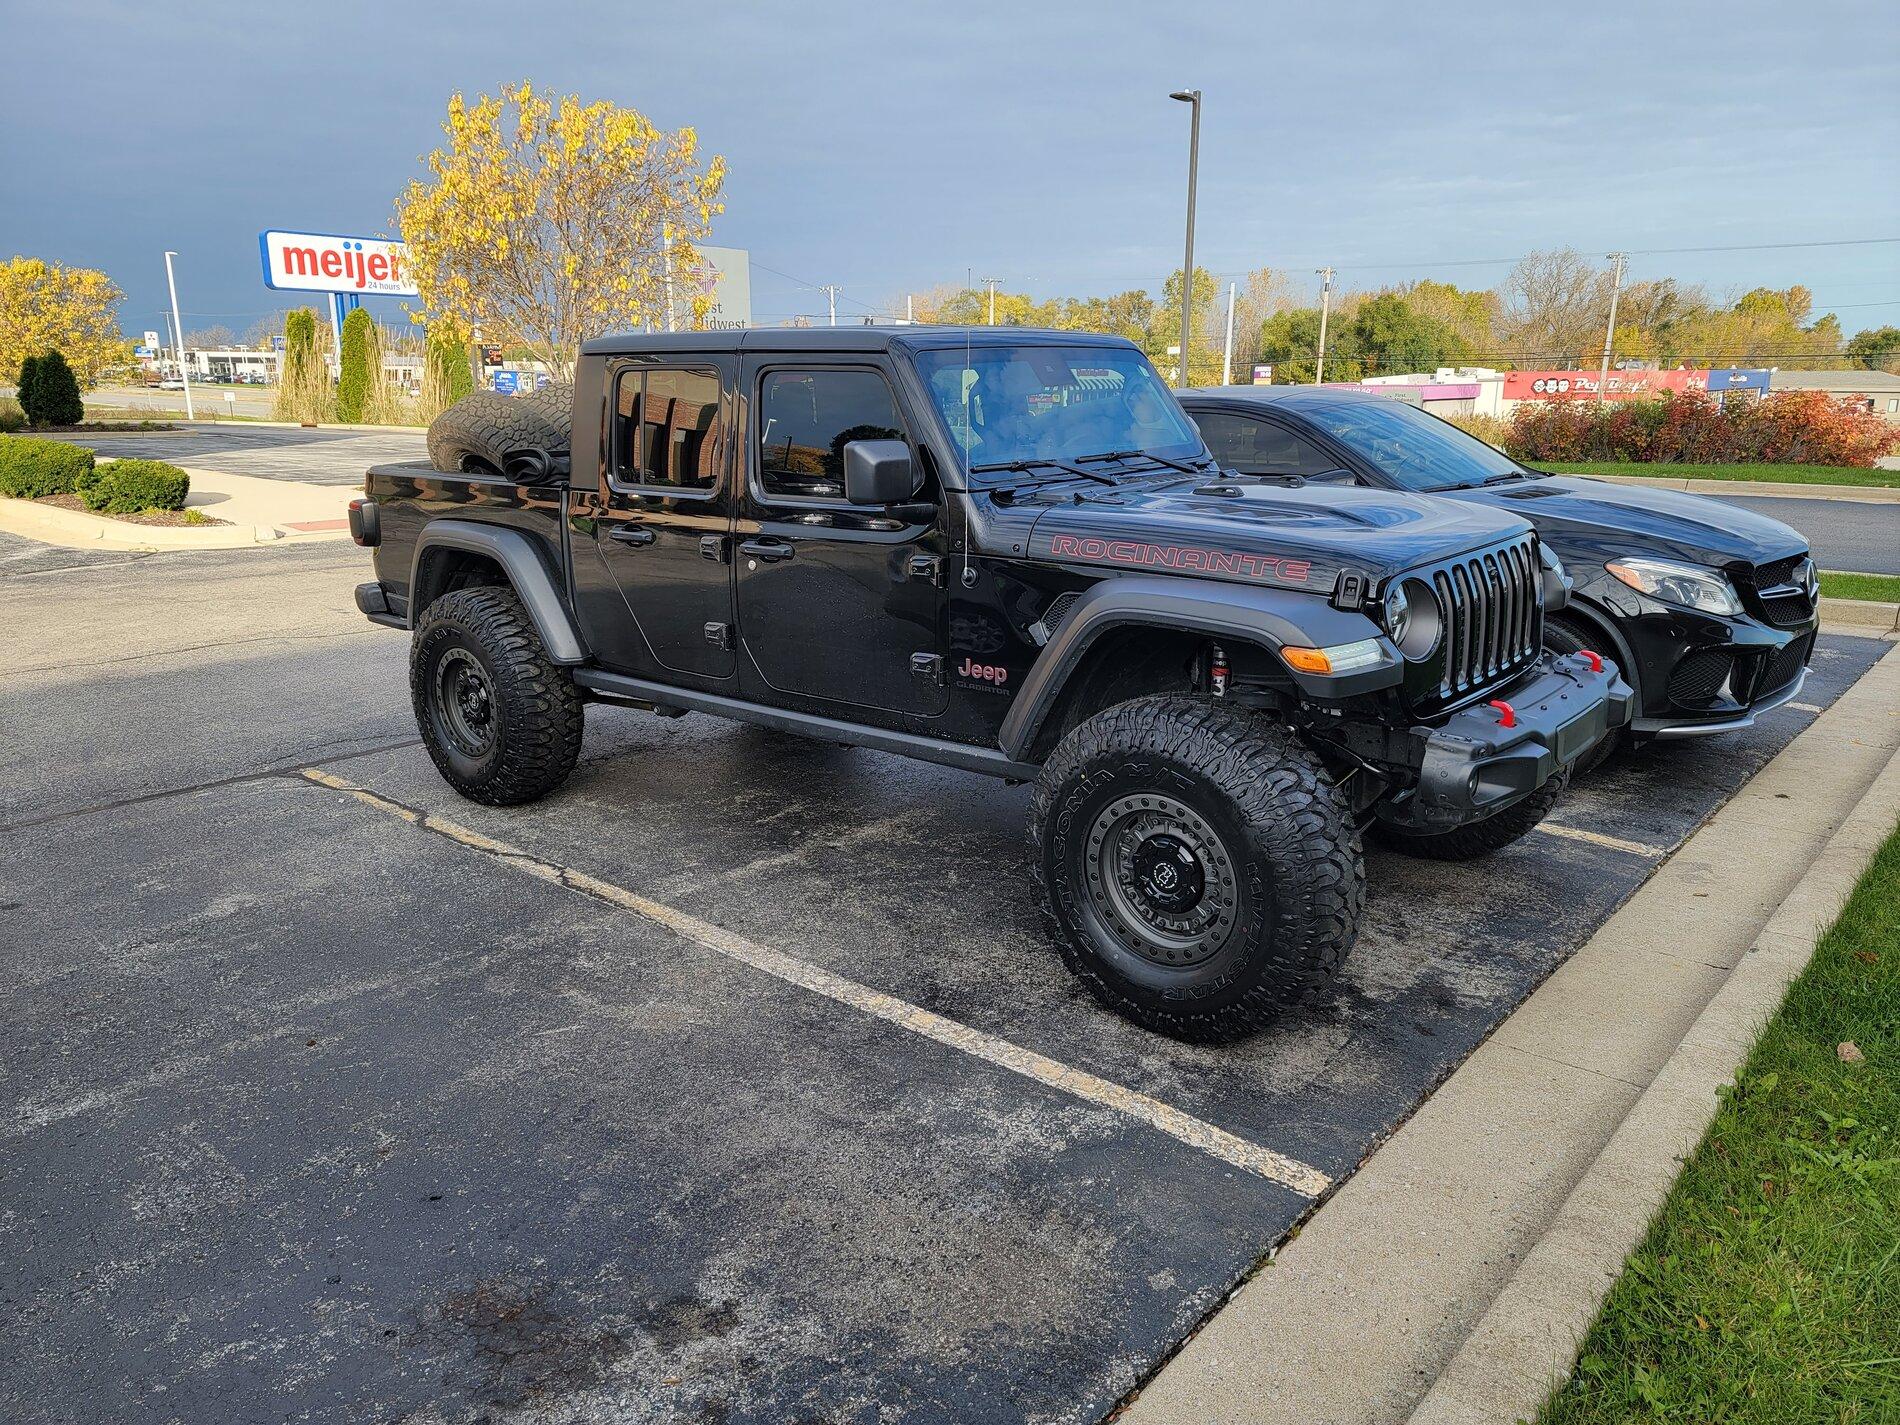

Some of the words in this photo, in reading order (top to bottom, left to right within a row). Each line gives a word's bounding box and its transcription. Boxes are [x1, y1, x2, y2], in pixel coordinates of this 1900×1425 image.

[367, 281, 378, 289] 24
[379, 282, 401, 291] hours
[1052, 535, 1311, 582] ROCINANTE
[958, 658, 1008, 686] Jeep
[956, 680, 1011, 696] GLADIATOR
